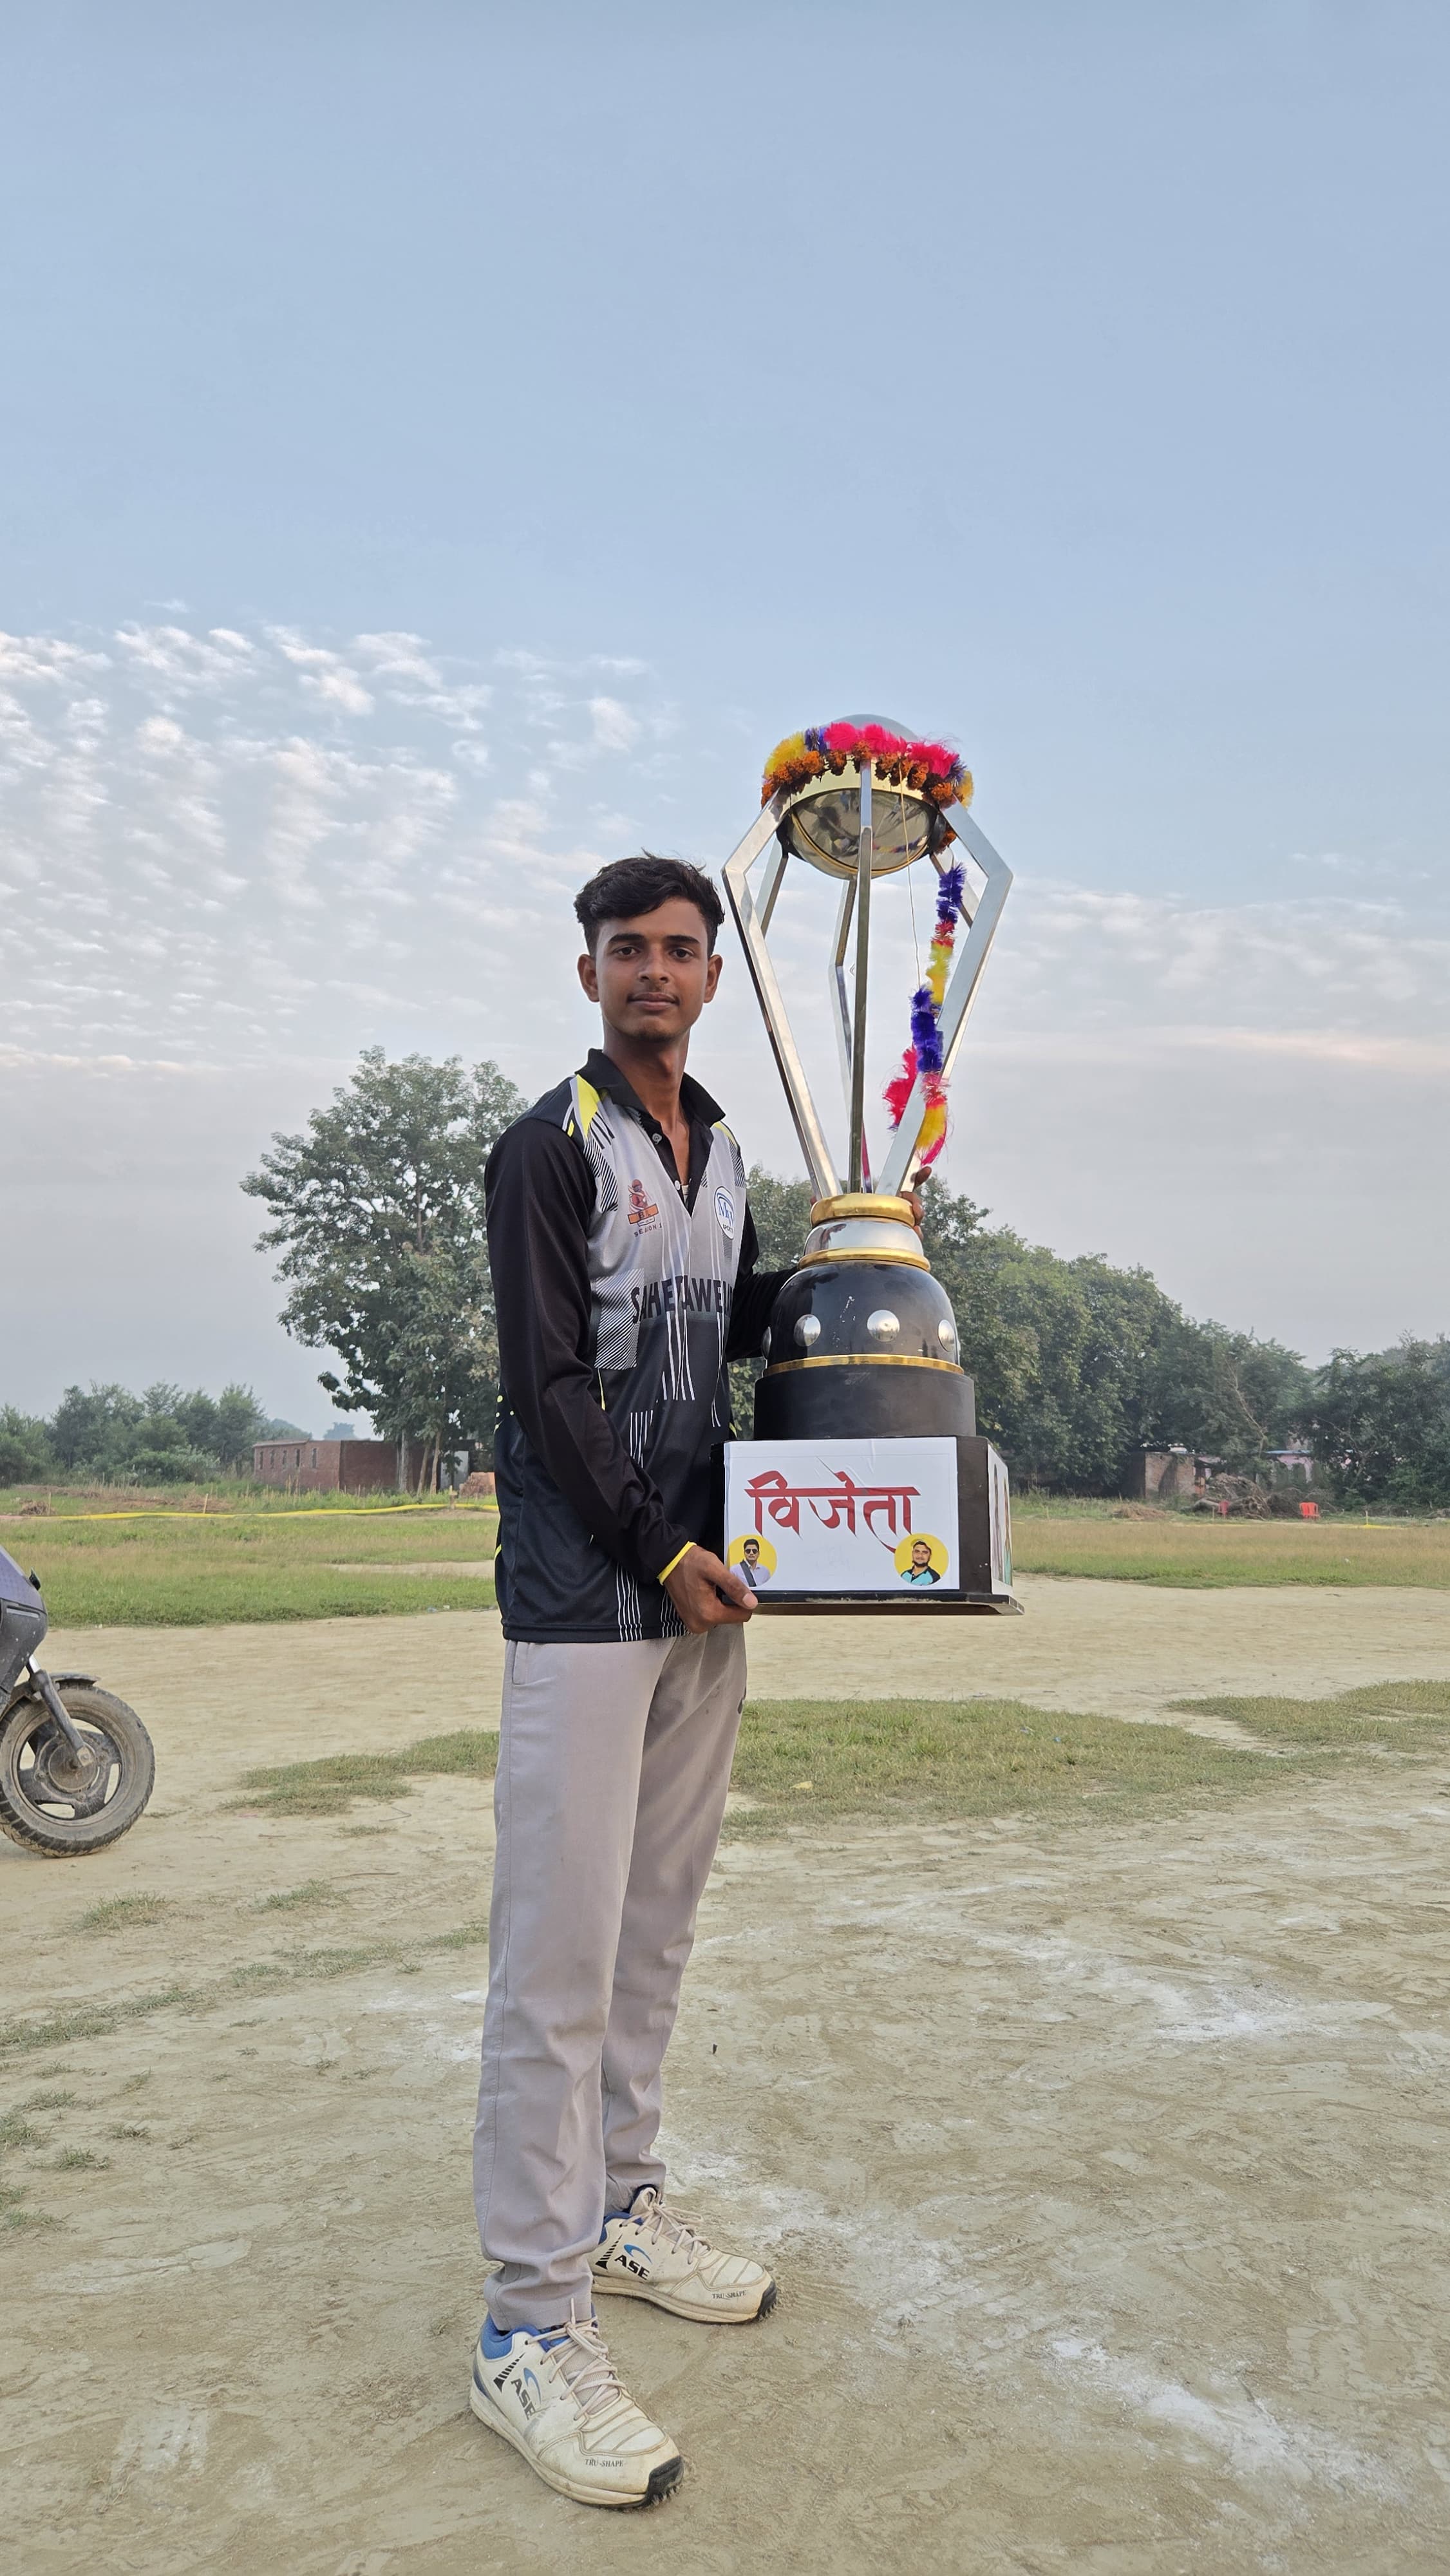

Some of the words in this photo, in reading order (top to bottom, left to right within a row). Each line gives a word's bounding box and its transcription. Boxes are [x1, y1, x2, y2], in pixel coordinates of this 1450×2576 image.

[743, 1457, 921, 1553] विजेता
[614, 2255, 650, 2280] ASE
[511, 2378, 536, 2421] ASE
